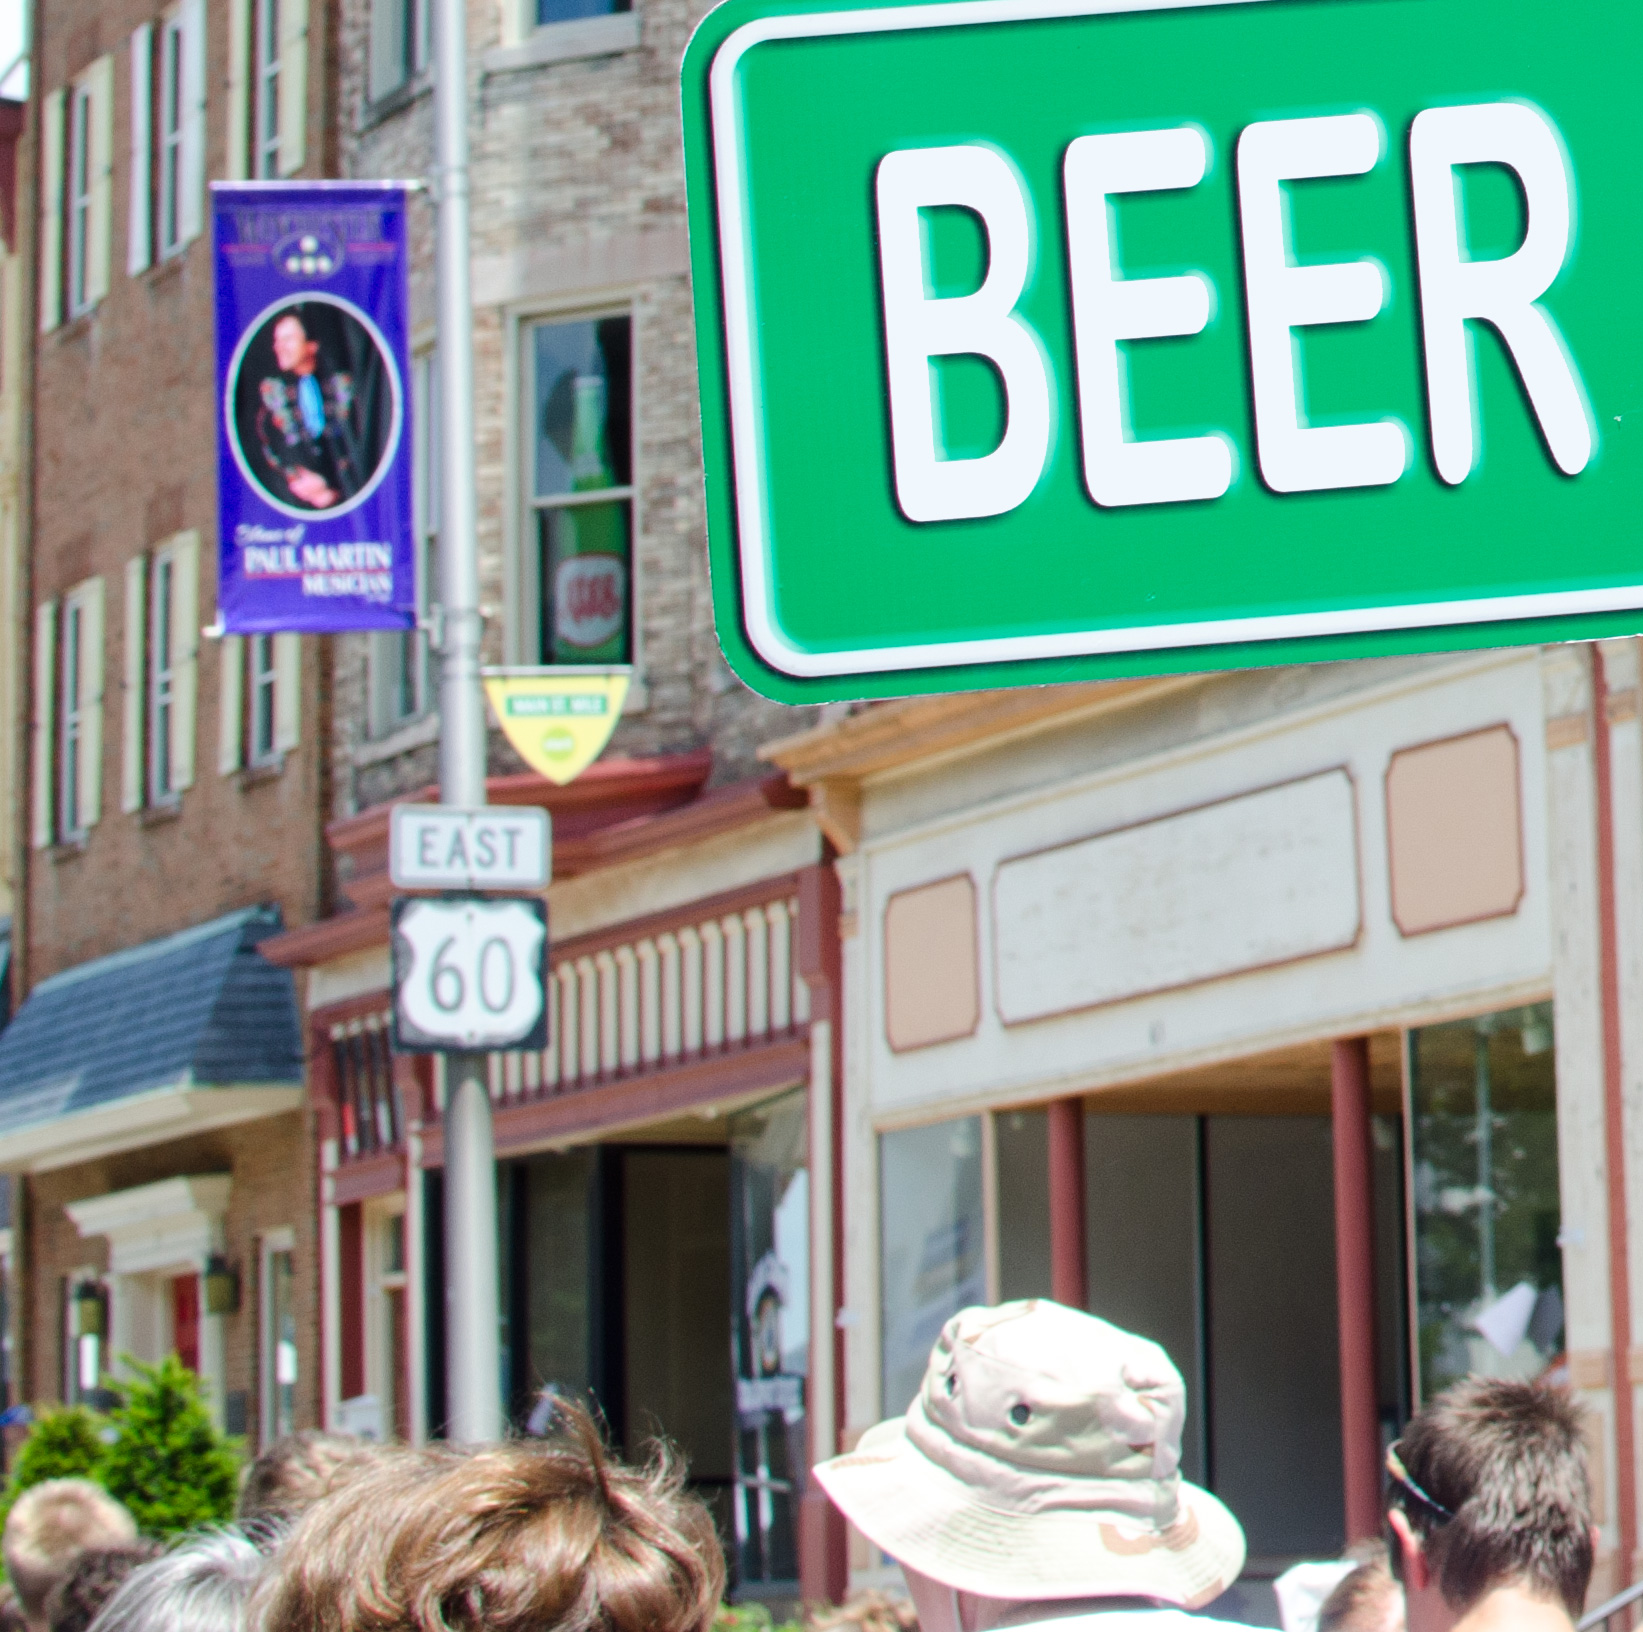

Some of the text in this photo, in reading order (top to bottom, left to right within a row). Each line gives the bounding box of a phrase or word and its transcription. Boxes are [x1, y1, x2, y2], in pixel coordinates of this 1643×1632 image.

[874, 101, 1594, 523] BEER
[244, 541, 393, 574] PAUL MARTIN
[302, 571, 393, 598] MUSICIAN
[512, 697, 550, 713] MAIN
[570, 695, 603, 711] MILE
[417, 827, 522, 870] EAST
[428, 935, 517, 1014] 60
